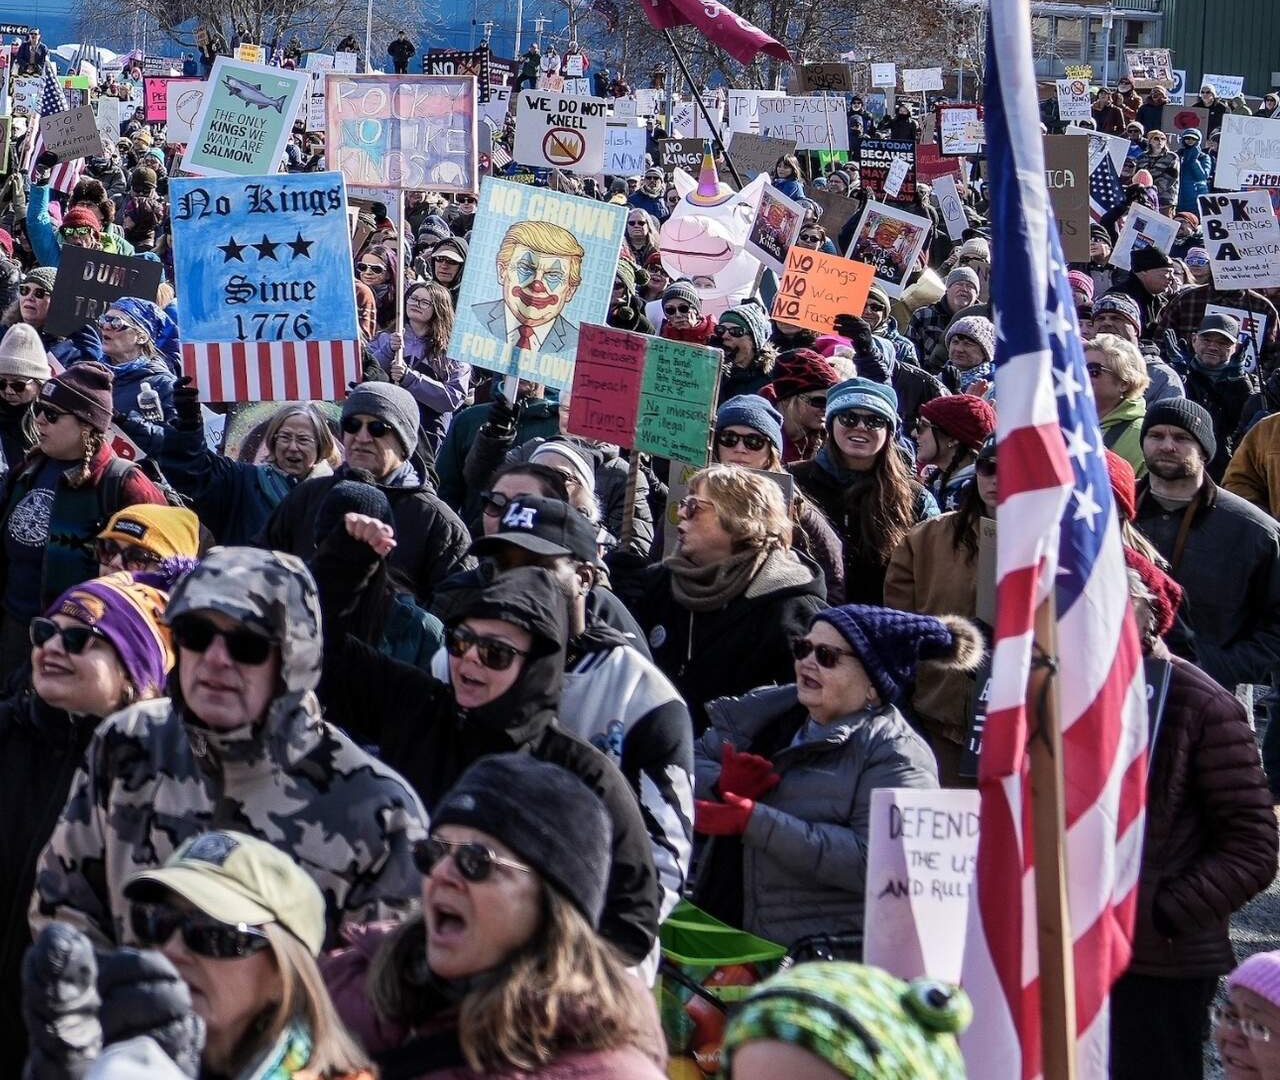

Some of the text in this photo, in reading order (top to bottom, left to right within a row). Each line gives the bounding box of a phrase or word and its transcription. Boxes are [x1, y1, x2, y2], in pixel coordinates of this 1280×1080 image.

[1059, 84, 1070, 95] No
[336, 81, 465, 126] ROCKY
[525, 96, 606, 117] WE DO NOT
[760, 99, 845, 113] STOP FASCISM
[45, 113, 83, 131] STOP
[214, 109, 267, 128] THE ONLY
[547, 113, 587, 130] KNEEL
[674, 104, 689, 123] SAVE
[209, 121, 267, 141] KINGS WE
[341, 118, 382, 149] NO
[207, 131, 264, 153] WANT ARE
[665, 143, 682, 154] NO
[860, 140, 913, 150] ACT TODAY
[202, 144, 254, 164] SALMON.
[611, 155, 642, 170] NOW
[663, 153, 703, 166] KINGS
[861, 150, 914, 161] BECAUSE
[336, 151, 428, 189] KINGS
[175, 183, 341, 221] No Kings
[1199, 196, 1266, 221] No KING
[490, 189, 616, 240] NO CROWN
[1207, 220, 1272, 240] BELONGS
[1239, 232, 1253, 240] IN
[1216, 243, 1280, 260] AMERICA
[789, 252, 857, 283] NO Kings
[864, 260, 894, 278] KINGS
[225, 275, 316, 305] Since
[783, 277, 849, 303] NO War
[774, 301, 800, 317] NO
[234, 313, 312, 341] 1776
[461, 334, 514, 364] FOR A
[580, 374, 628, 392] Impeach
[661, 419, 685, 435] illegal
[890, 803, 980, 841] DEFEND
[909, 850, 941, 867] THE
[878, 880, 924, 901] AND
